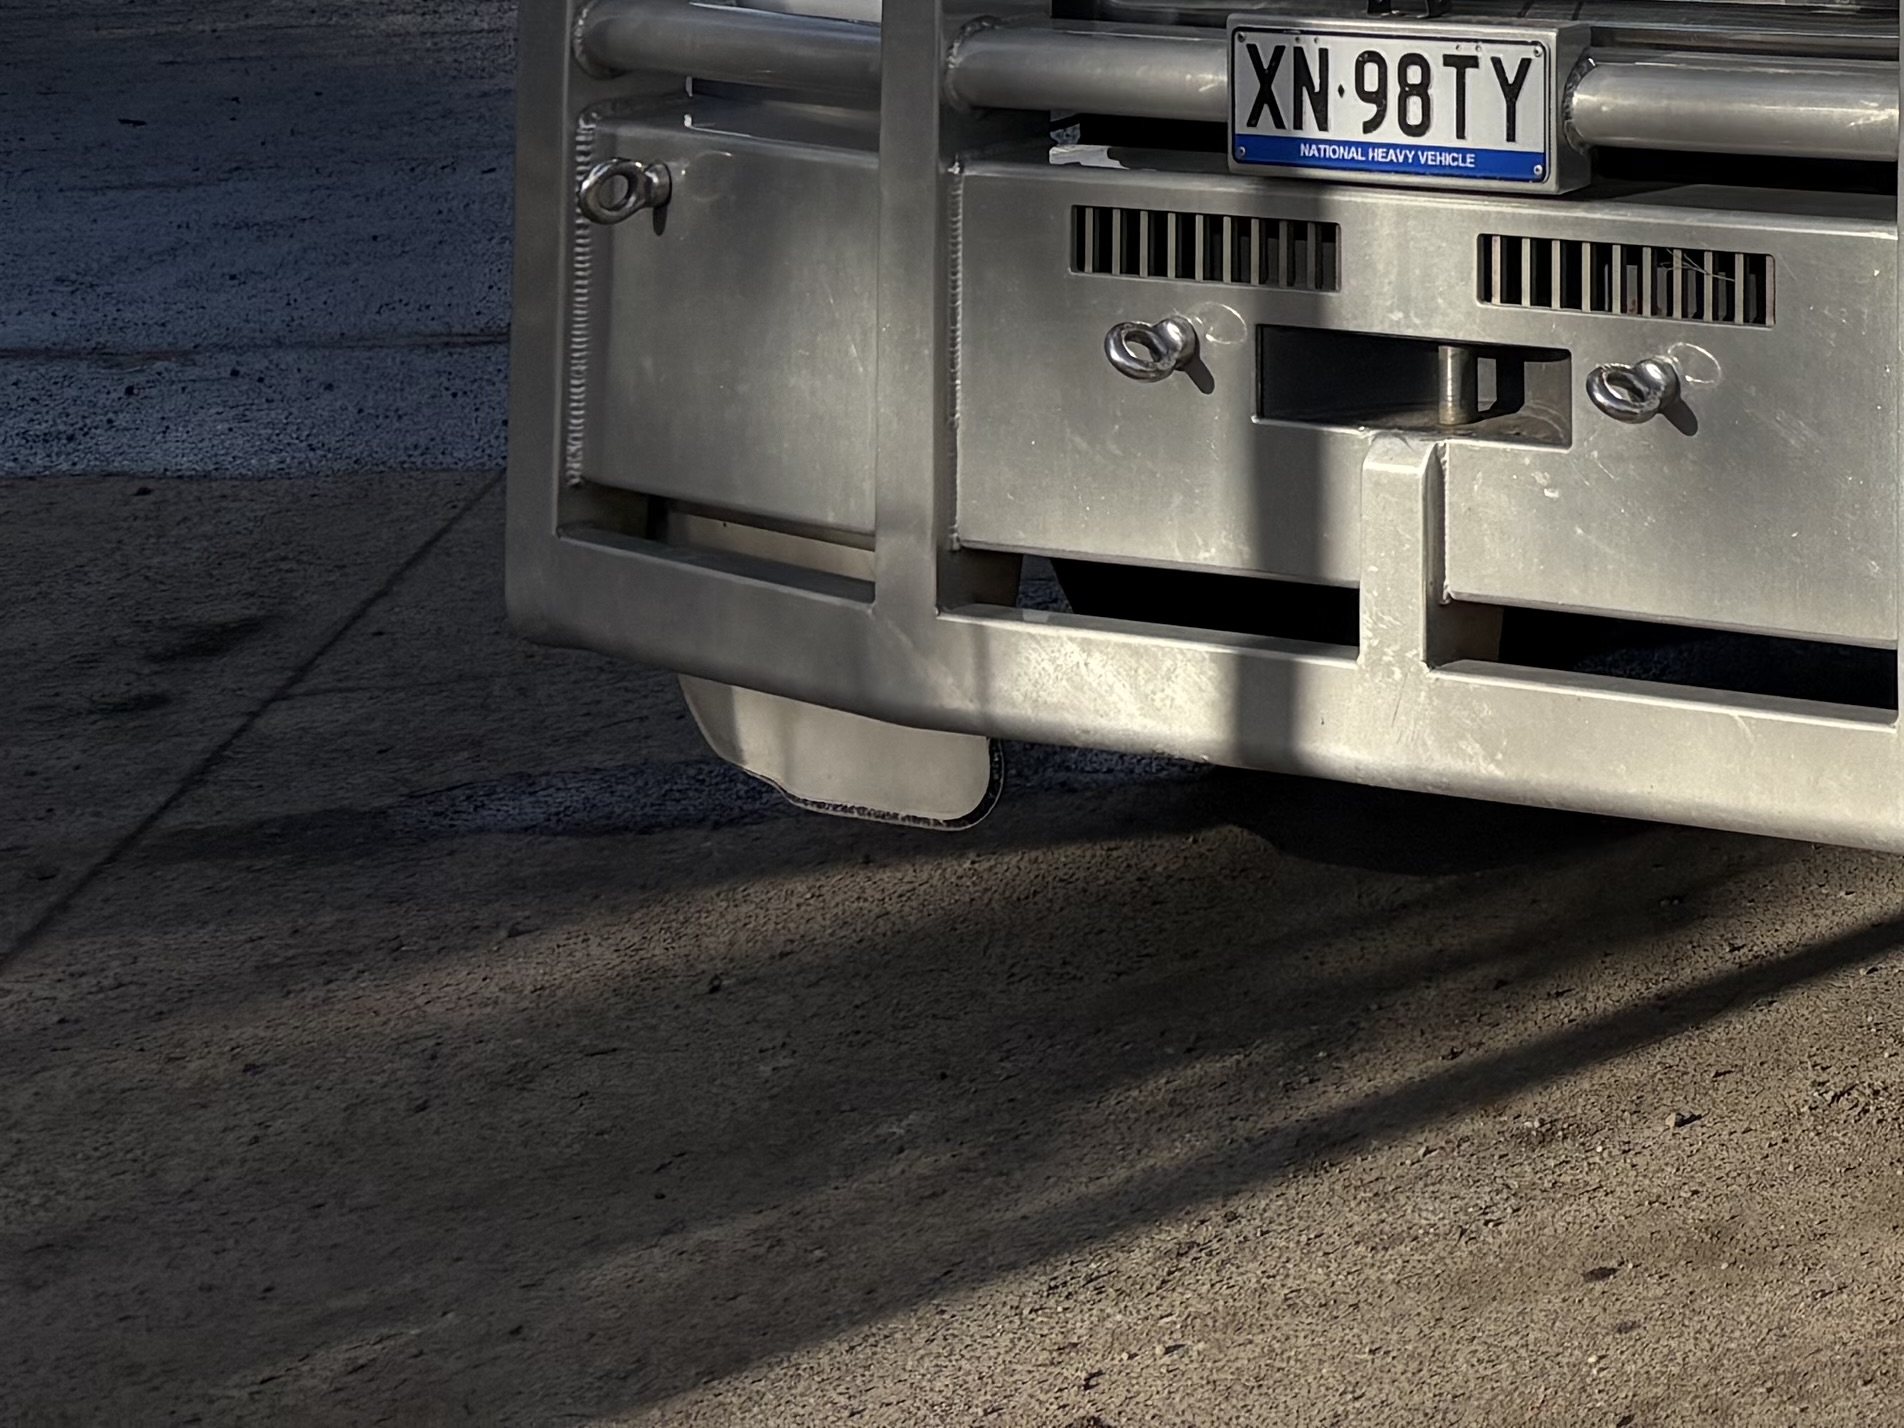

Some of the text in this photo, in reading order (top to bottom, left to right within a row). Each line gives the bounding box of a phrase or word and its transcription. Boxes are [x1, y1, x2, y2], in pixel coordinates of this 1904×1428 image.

[1299, 142, 1476, 168] NATIONAL HEAVY VEHICLE
